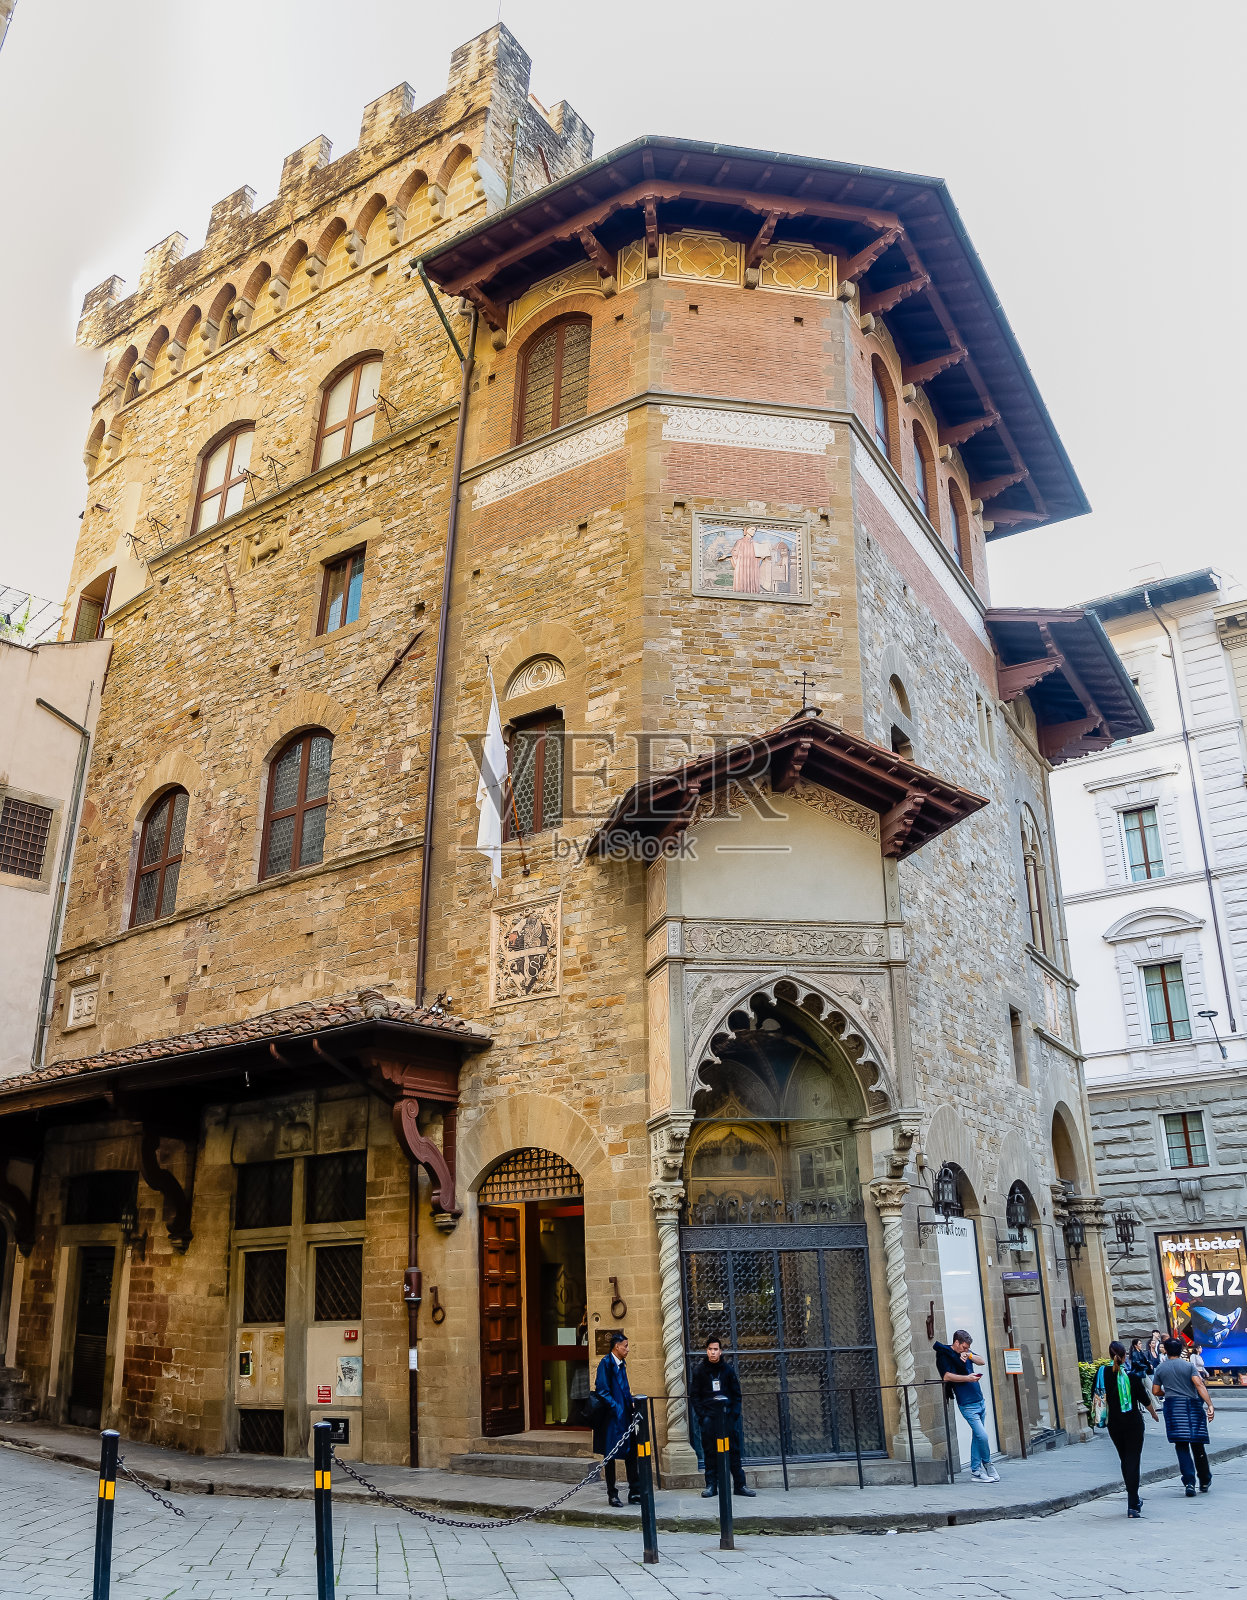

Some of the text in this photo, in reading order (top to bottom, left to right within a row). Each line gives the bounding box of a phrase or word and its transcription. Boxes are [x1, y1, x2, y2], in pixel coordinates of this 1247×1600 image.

[1162, 1236, 1241, 1252] Foot Locker
[1188, 1272, 1243, 1297] SL72
